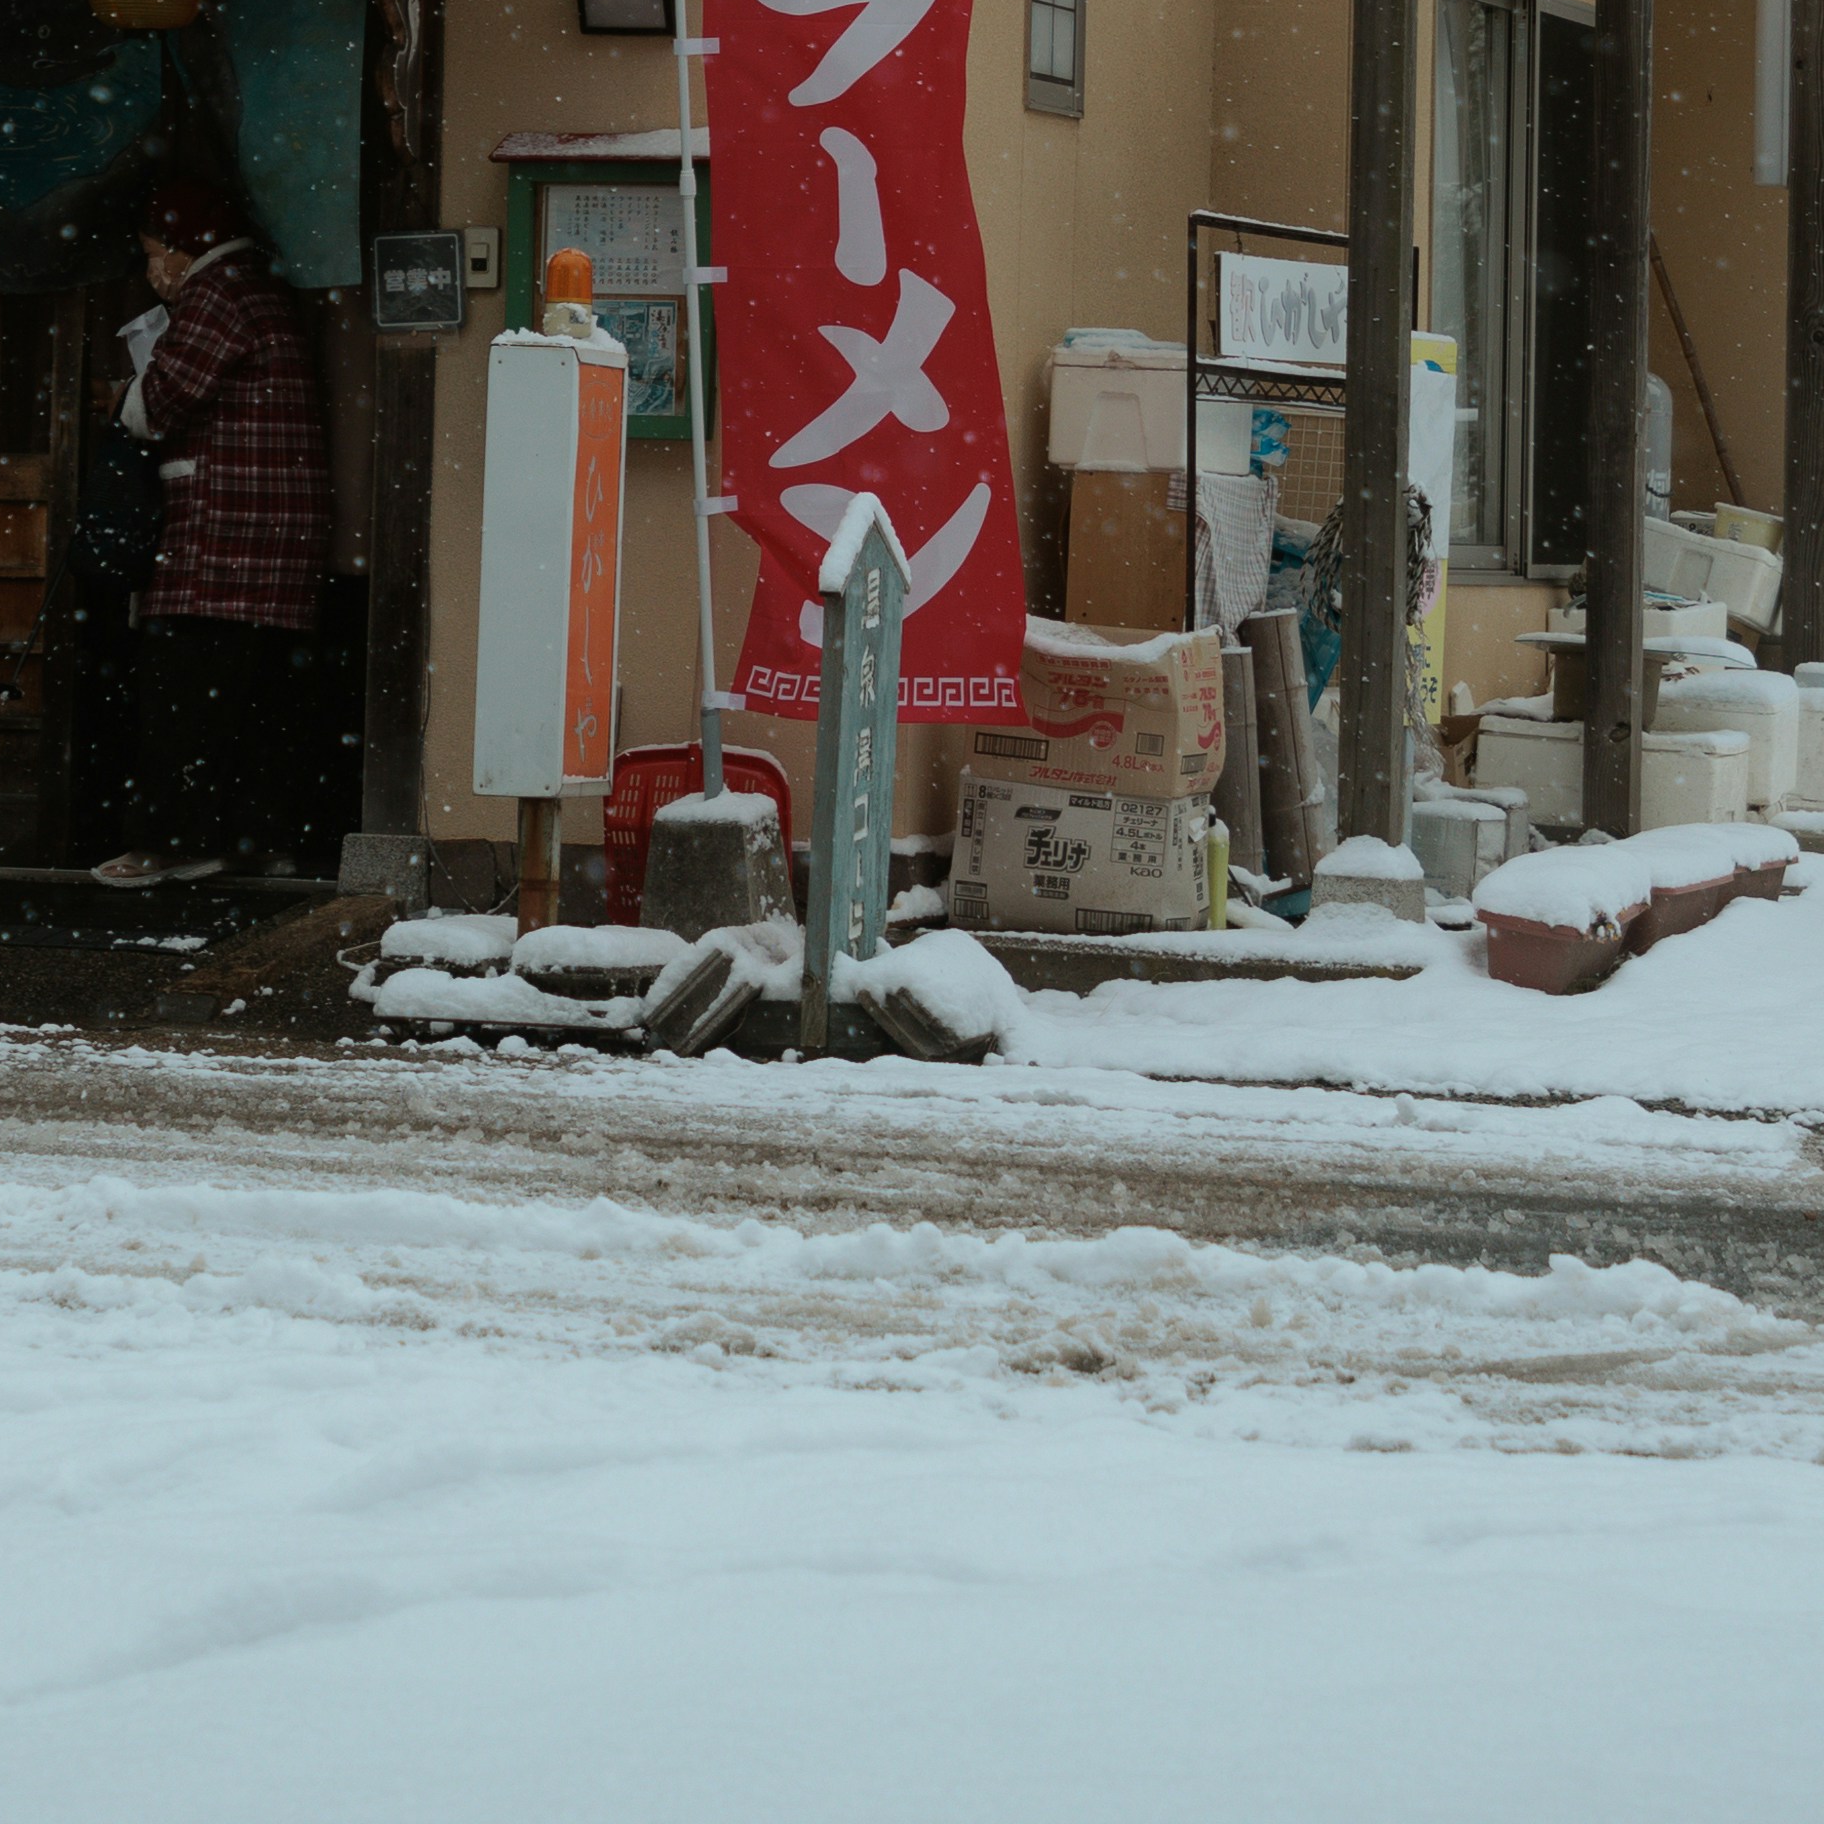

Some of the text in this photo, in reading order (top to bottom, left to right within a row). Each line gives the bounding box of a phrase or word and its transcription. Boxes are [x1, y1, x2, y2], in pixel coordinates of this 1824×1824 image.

[383, 267, 452, 293] 営業中
[573, 454, 605, 764] ひがしや
[1120, 802, 1163, 817] 02127
[1122, 817, 1159, 827] チェリーナ
[1129, 841, 1147, 851] 4本
[1034, 874, 1071, 891] 業務用
